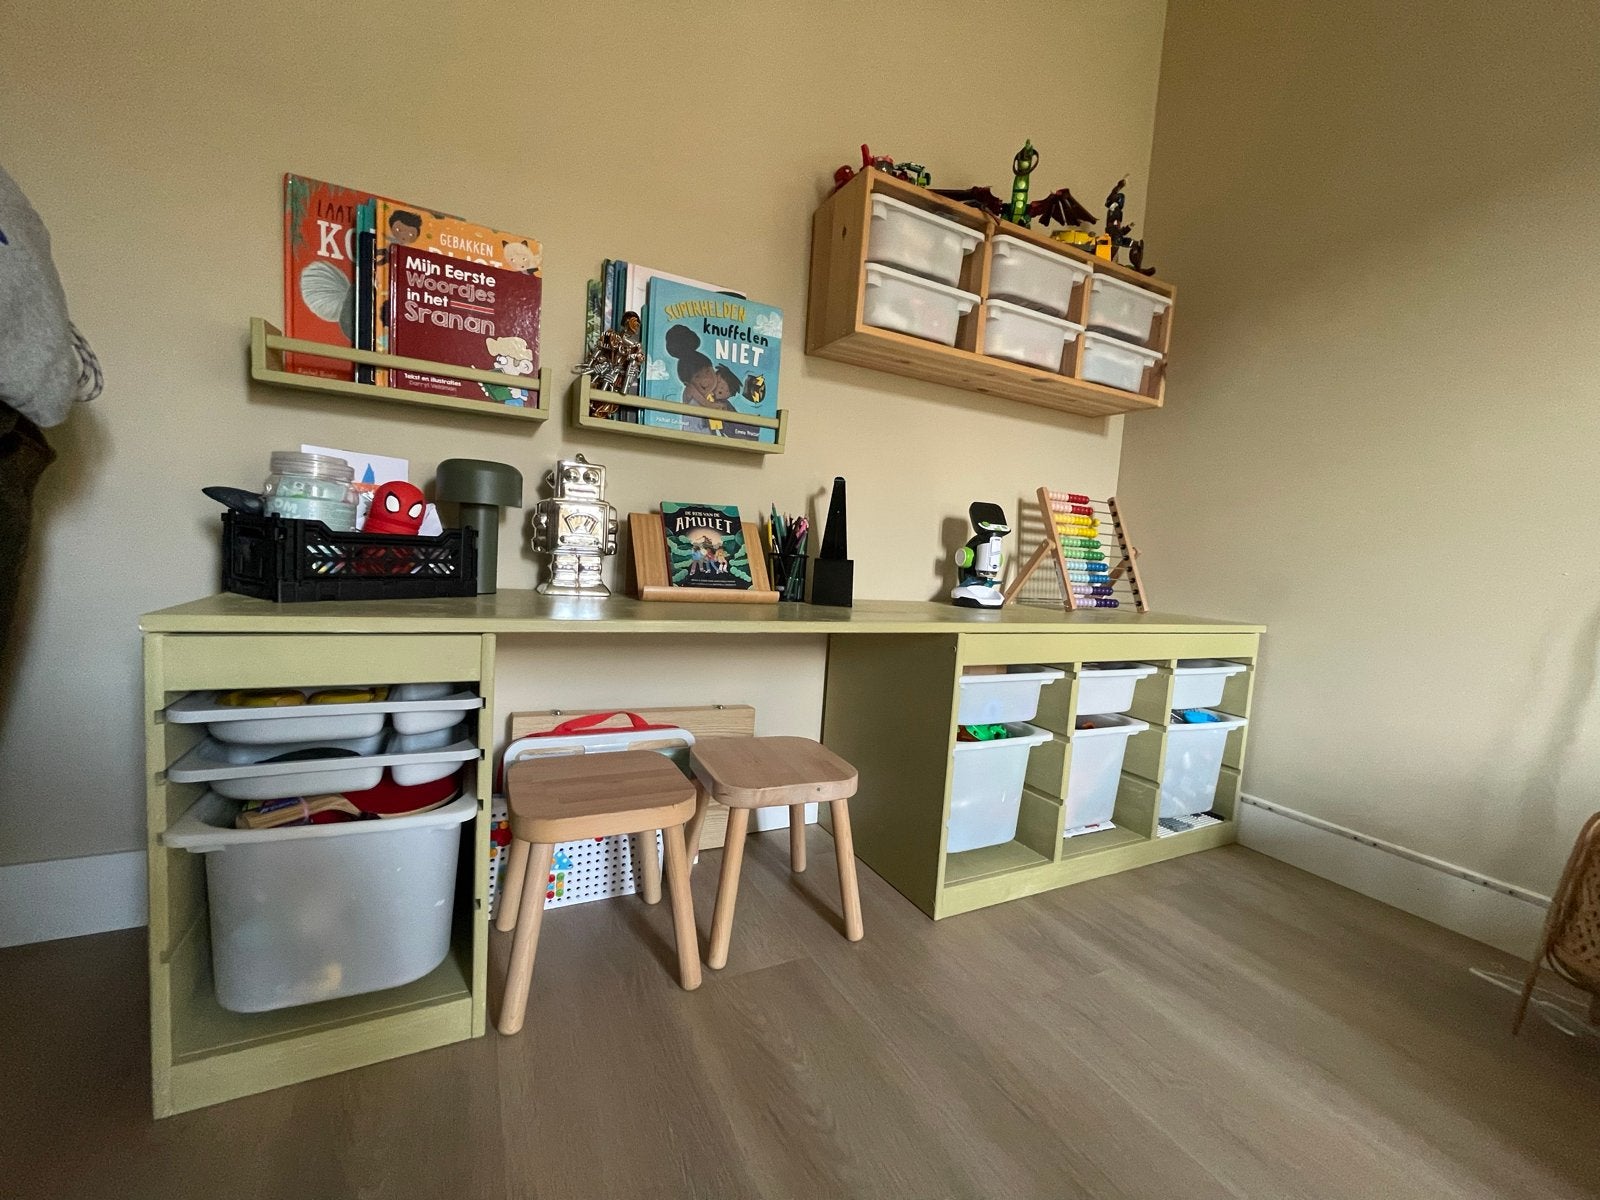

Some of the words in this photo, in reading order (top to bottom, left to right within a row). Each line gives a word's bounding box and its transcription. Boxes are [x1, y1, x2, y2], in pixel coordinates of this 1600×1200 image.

[317, 199, 354, 224] LAAT
[440, 233, 494, 258] GEBAKKEN
[405, 256, 441, 276] Mijn
[445, 264, 496, 287] Eerste
[405, 270, 496, 304] Woordjes
[406, 288, 420, 302] in
[424, 291, 449, 307] het
[404, 300, 495, 336] Sranan
[664, 300, 746, 323] SUPERHELDEN
[703, 318, 769, 347] knuffelen
[715, 339, 764, 367] NIET
[675, 516, 733, 534] AMULET
